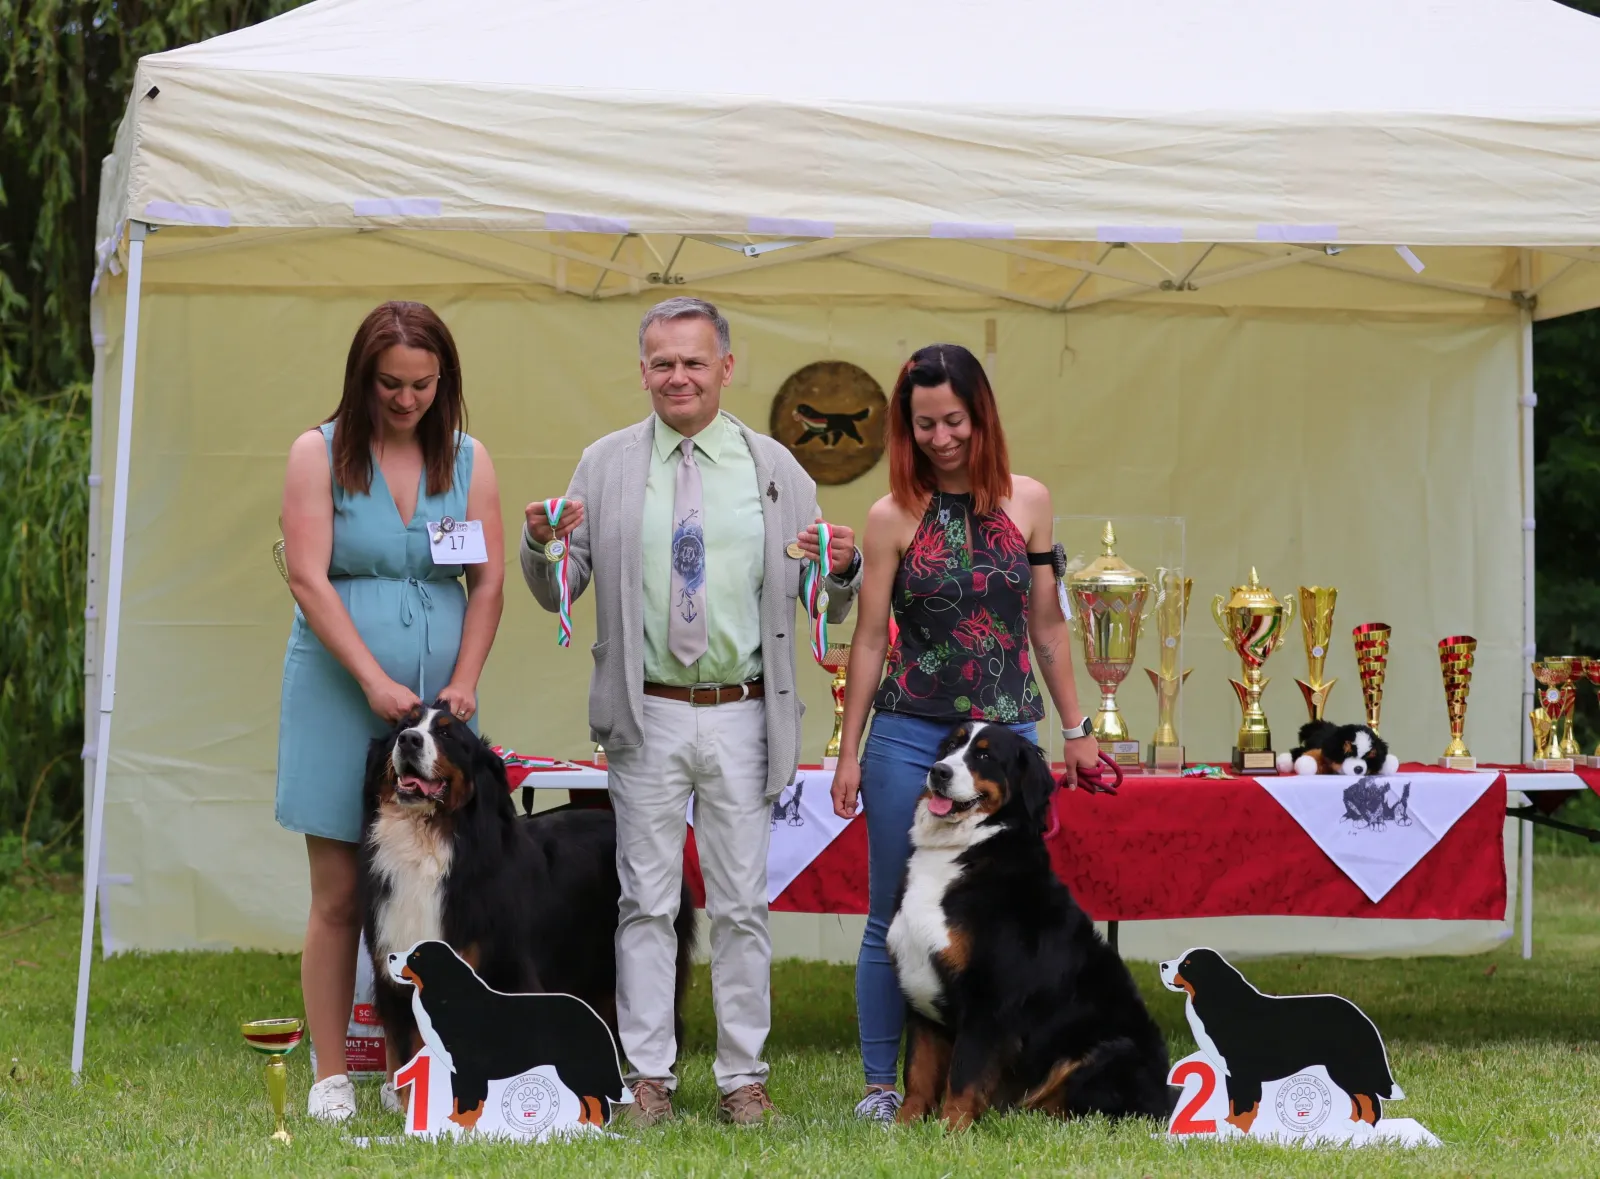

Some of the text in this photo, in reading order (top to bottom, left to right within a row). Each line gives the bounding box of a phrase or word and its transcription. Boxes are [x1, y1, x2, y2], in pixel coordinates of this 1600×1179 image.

[449, 535, 465, 550] 17
[358, 1009, 370, 1017] SC
[345, 1039, 361, 1048] ULT
[397, 1055, 430, 1131] 1
[505, 1080, 519, 1098] Svájci
[541, 1078, 557, 1098] Kutyák
[1170, 1061, 1217, 1134] 2
[1278, 1082, 1291, 1098] Svájci
[1313, 1079, 1328, 1097] Kutyák
